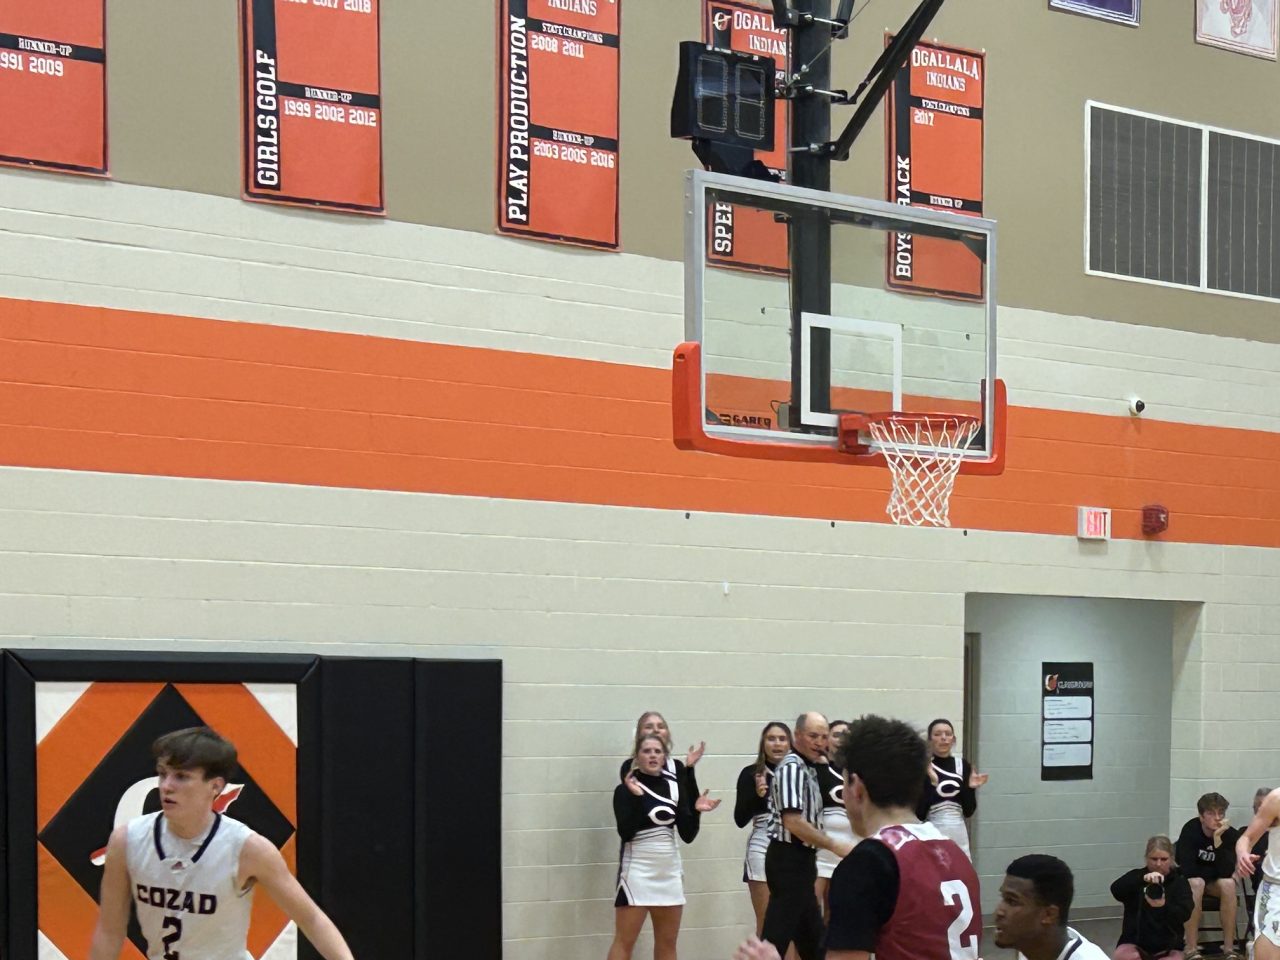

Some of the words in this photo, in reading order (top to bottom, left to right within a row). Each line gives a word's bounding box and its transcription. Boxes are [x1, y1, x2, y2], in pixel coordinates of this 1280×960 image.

[733, 11, 788, 35] OGALL
[749, 34, 787, 56] INDIAN
[0, 52, 24, 71] 991
[28, 56, 64, 77] 2009
[912, 48, 979, 80] OGALLALA
[255, 49, 278, 112] GOLF
[509, 14, 529, 162] PRODUCTION
[926, 71, 966, 92] INDIANS
[284, 99, 312, 118] 1999
[314, 104, 345, 122] 2002
[348, 108, 377, 127] 2012
[256, 113, 279, 186] GIRLS
[508, 163, 528, 222] PLAY
[714, 201, 732, 253] SPEE
[136, 884, 217, 915] COZAD
